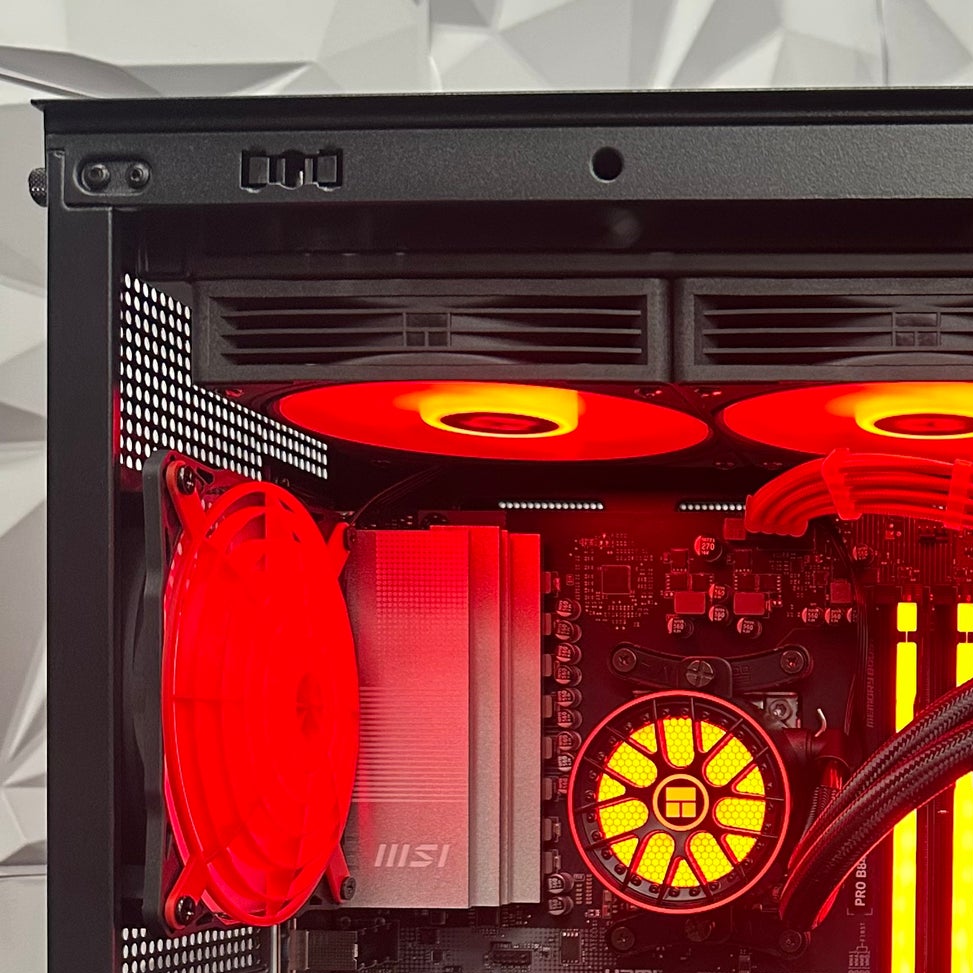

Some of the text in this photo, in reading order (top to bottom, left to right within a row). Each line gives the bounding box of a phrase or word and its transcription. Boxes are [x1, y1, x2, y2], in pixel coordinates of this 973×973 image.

[701, 543, 715, 551] 270
[374, 844, 450, 867] MSI
[854, 881, 867, 907] PRO
